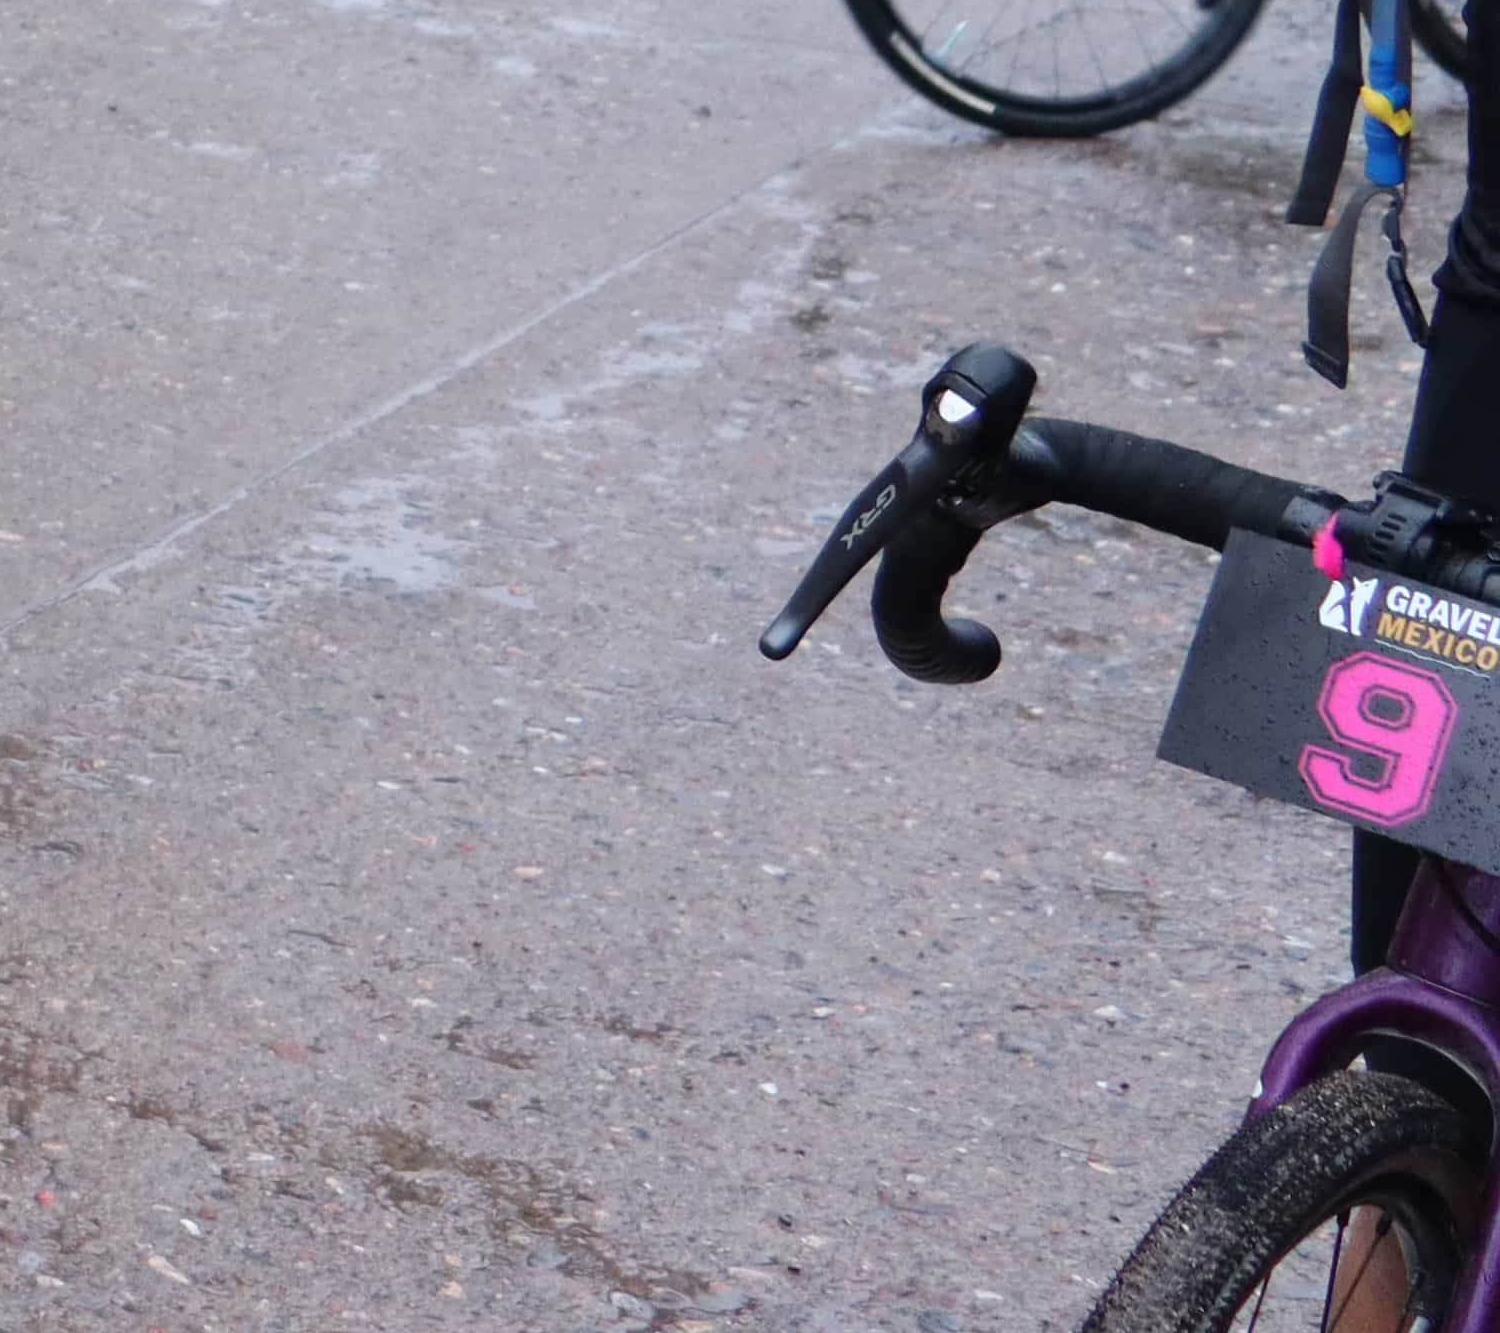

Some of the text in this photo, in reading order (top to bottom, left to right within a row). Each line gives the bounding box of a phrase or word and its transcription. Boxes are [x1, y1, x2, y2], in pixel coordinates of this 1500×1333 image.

[839, 483, 897, 551] GRX
[1386, 585, 1500, 646] GRAVEL
[1298, 650, 1459, 827] 9
